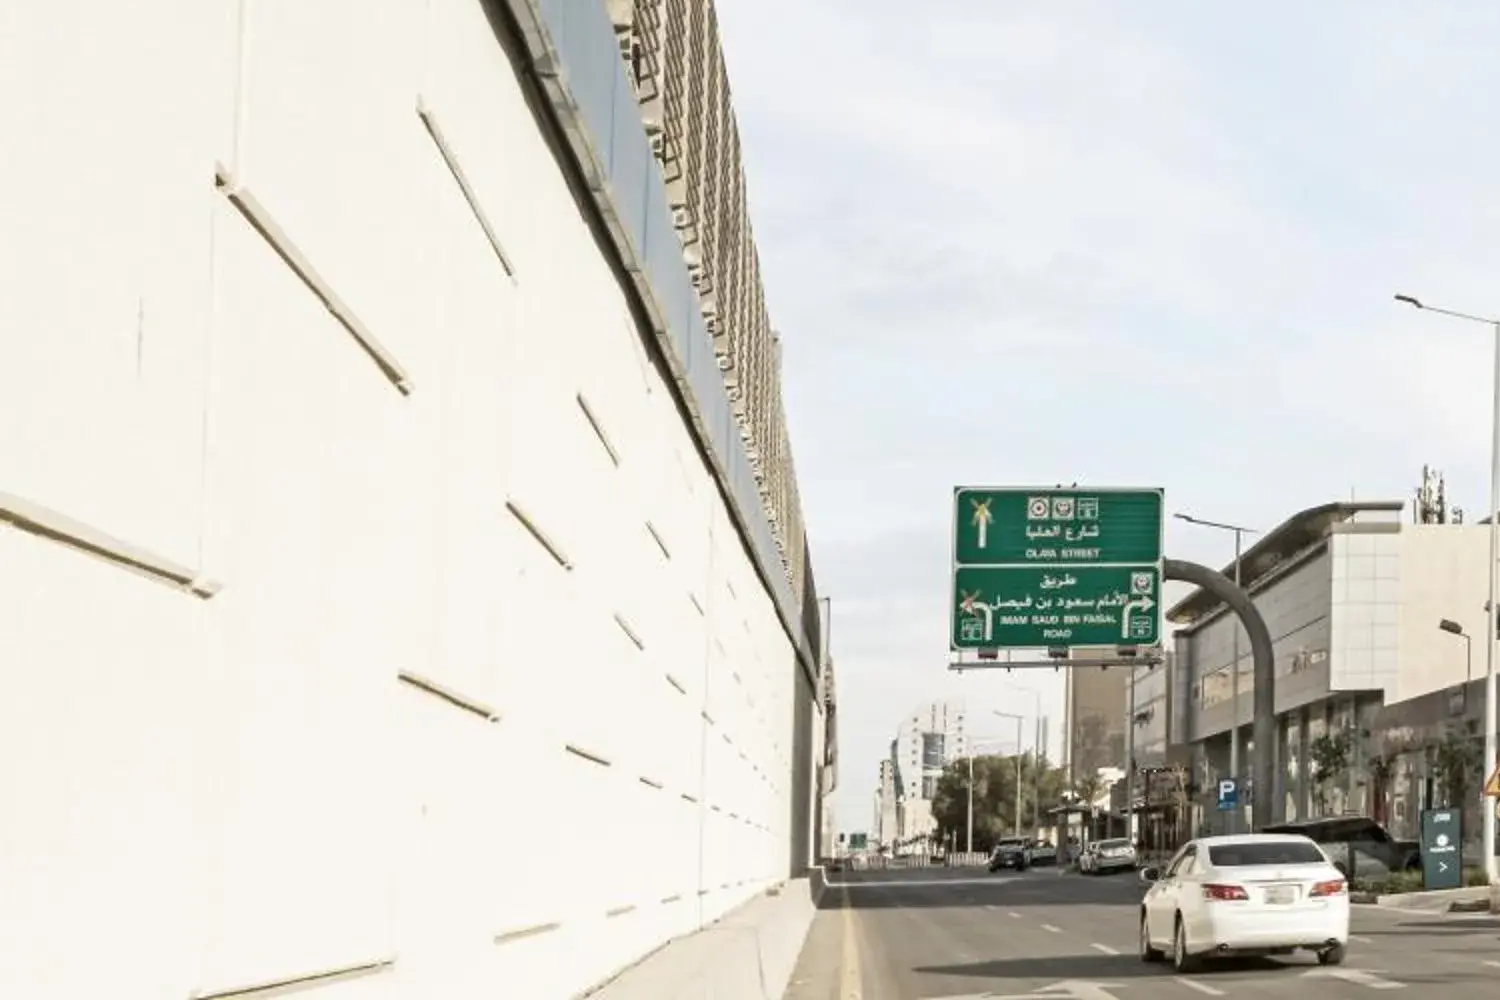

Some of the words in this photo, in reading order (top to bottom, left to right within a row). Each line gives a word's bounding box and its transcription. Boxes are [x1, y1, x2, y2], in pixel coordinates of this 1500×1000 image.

[1026, 525, 1060, 541] العليا
[1065, 524, 1099, 541] شارع
[1061, 548, 1100, 559] STREET
[1040, 573, 1077, 589] طريق
[1031, 615, 1059, 625] SAUD
[1043, 628, 1072, 639] ROAD
[1219, 780, 1235, 801] P
